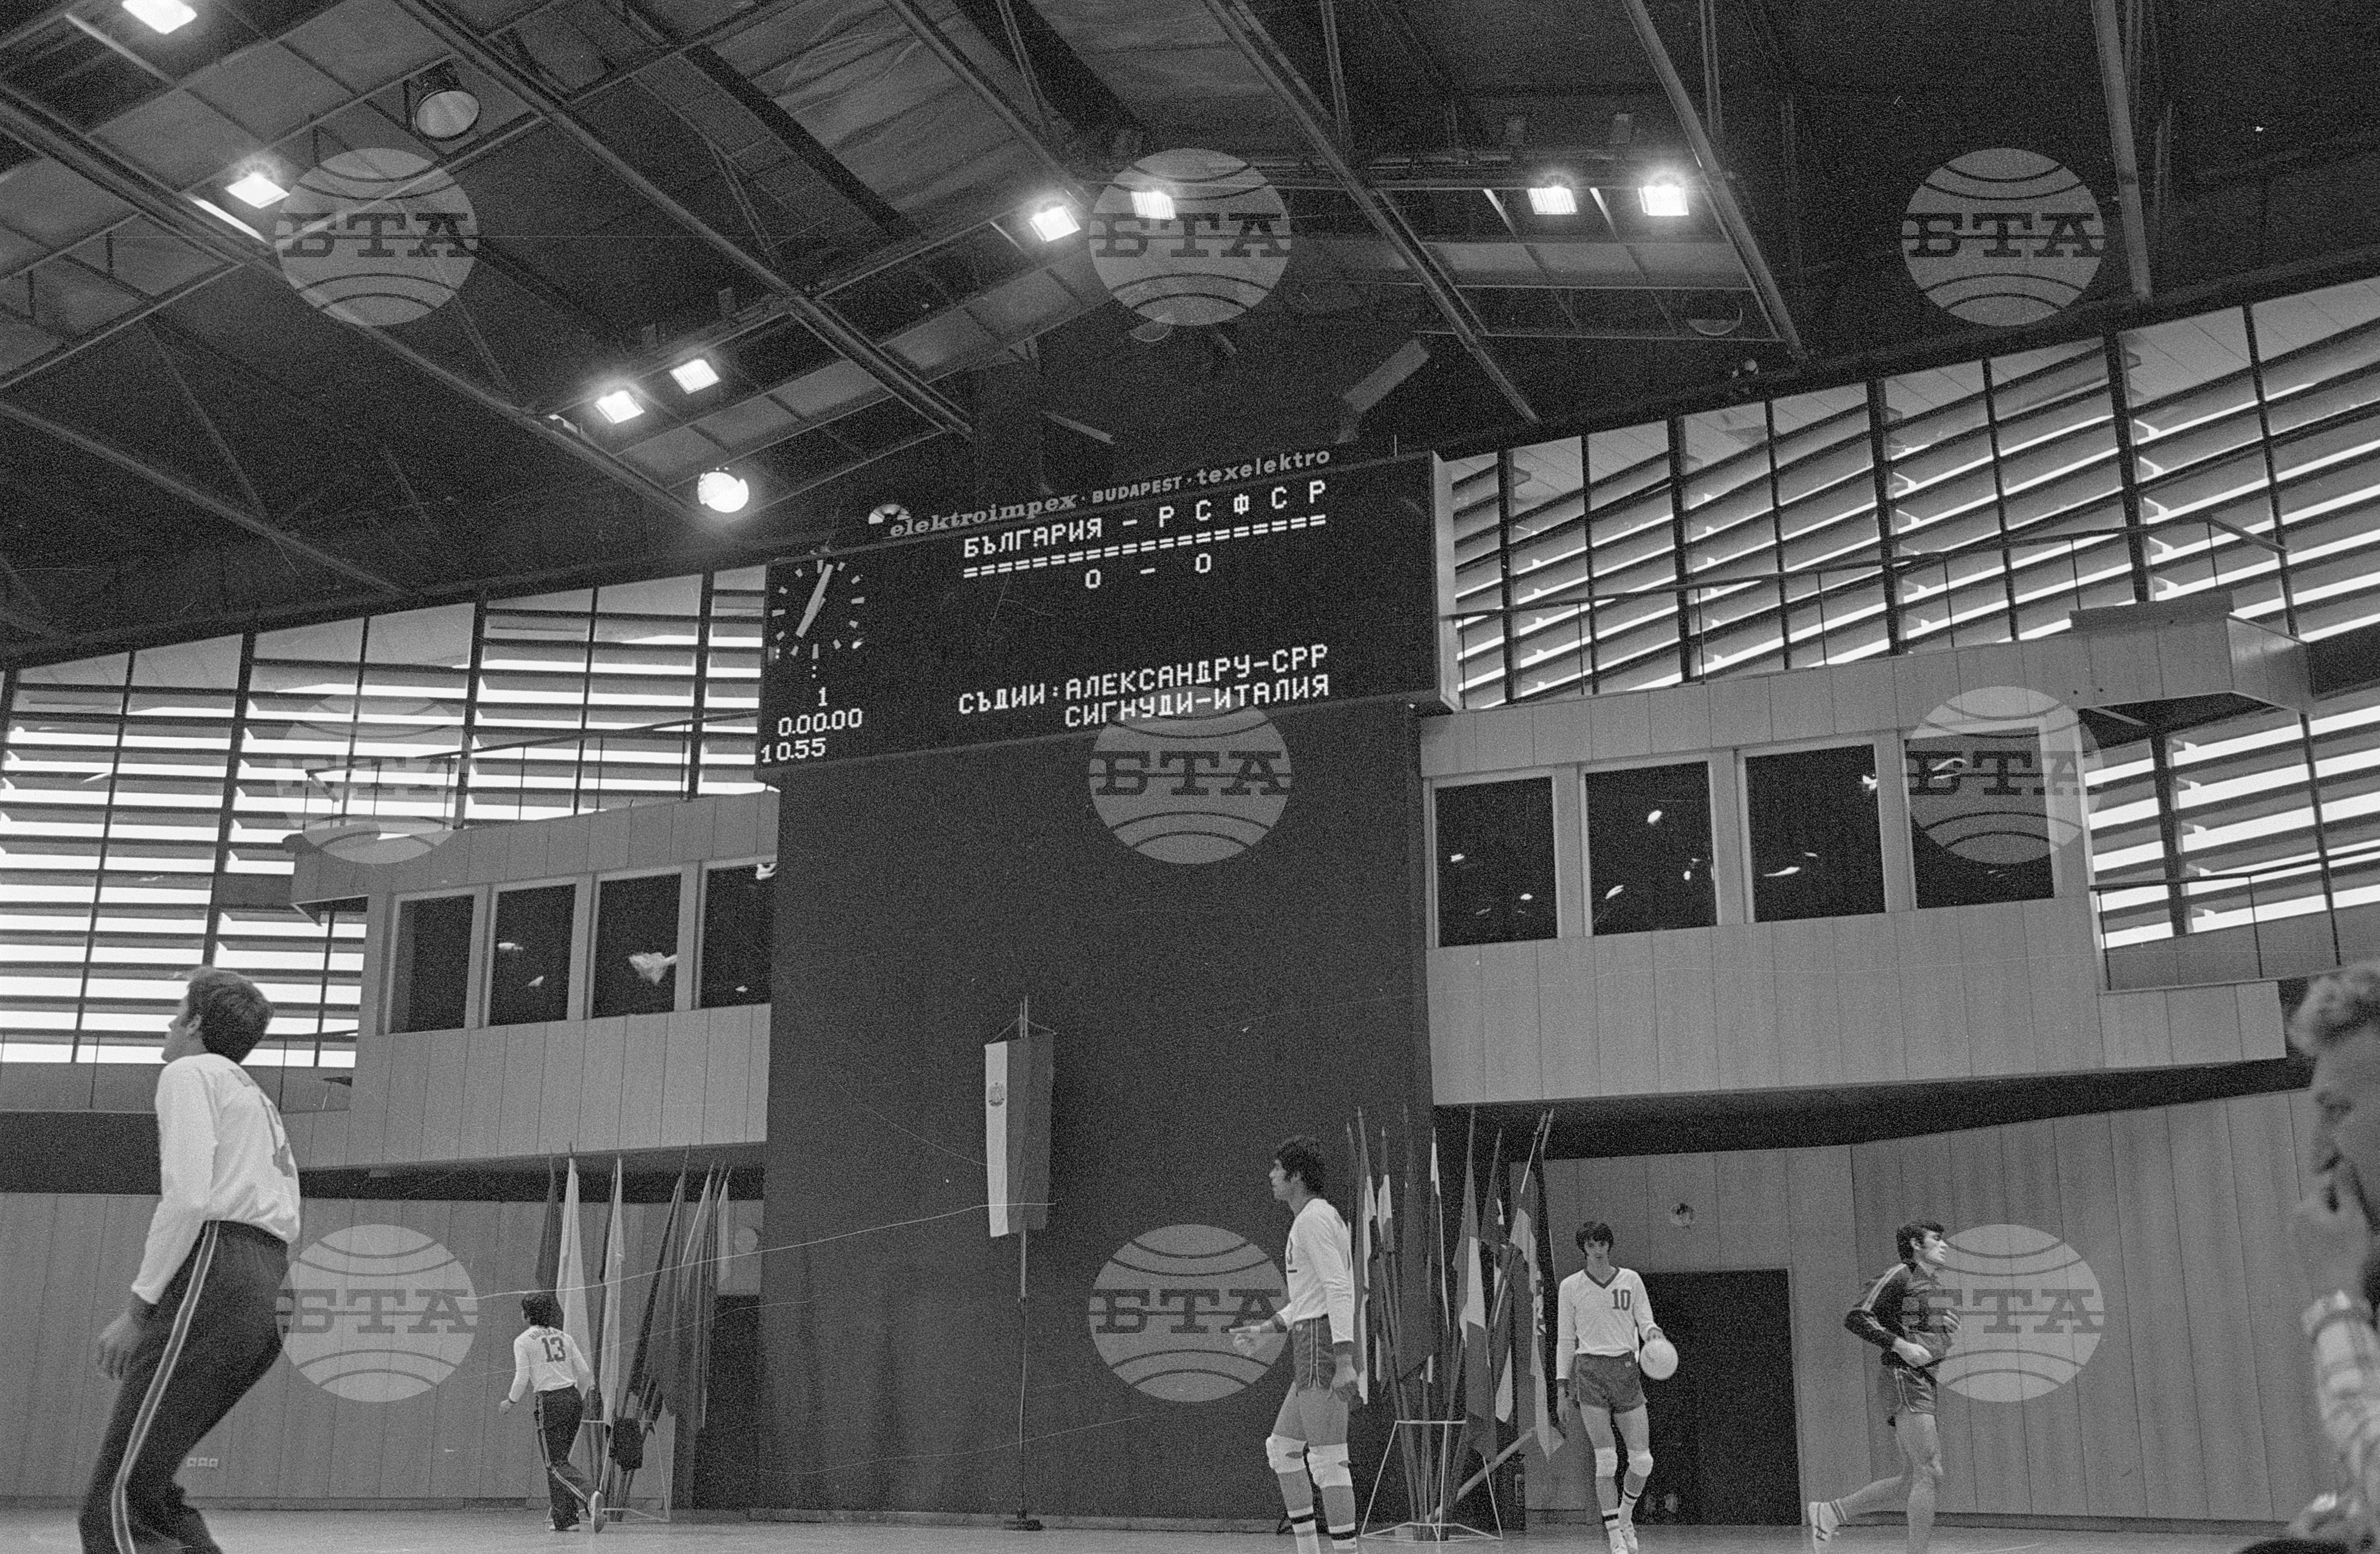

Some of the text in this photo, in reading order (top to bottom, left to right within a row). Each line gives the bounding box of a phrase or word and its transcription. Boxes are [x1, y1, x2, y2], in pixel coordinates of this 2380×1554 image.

[890, 450, 1330, 537] elektroimpex BUDAPEST texelektro
[963, 517, 1102, 558] БЪЛГАРИЯ
[818, 687, 828, 707] 1
[778, 708, 863, 736] 0.00.00
[760, 737, 826, 763] 10.55
[1611, 1288, 1631, 1311] 10
[541, 1336, 566, 1363] 13
